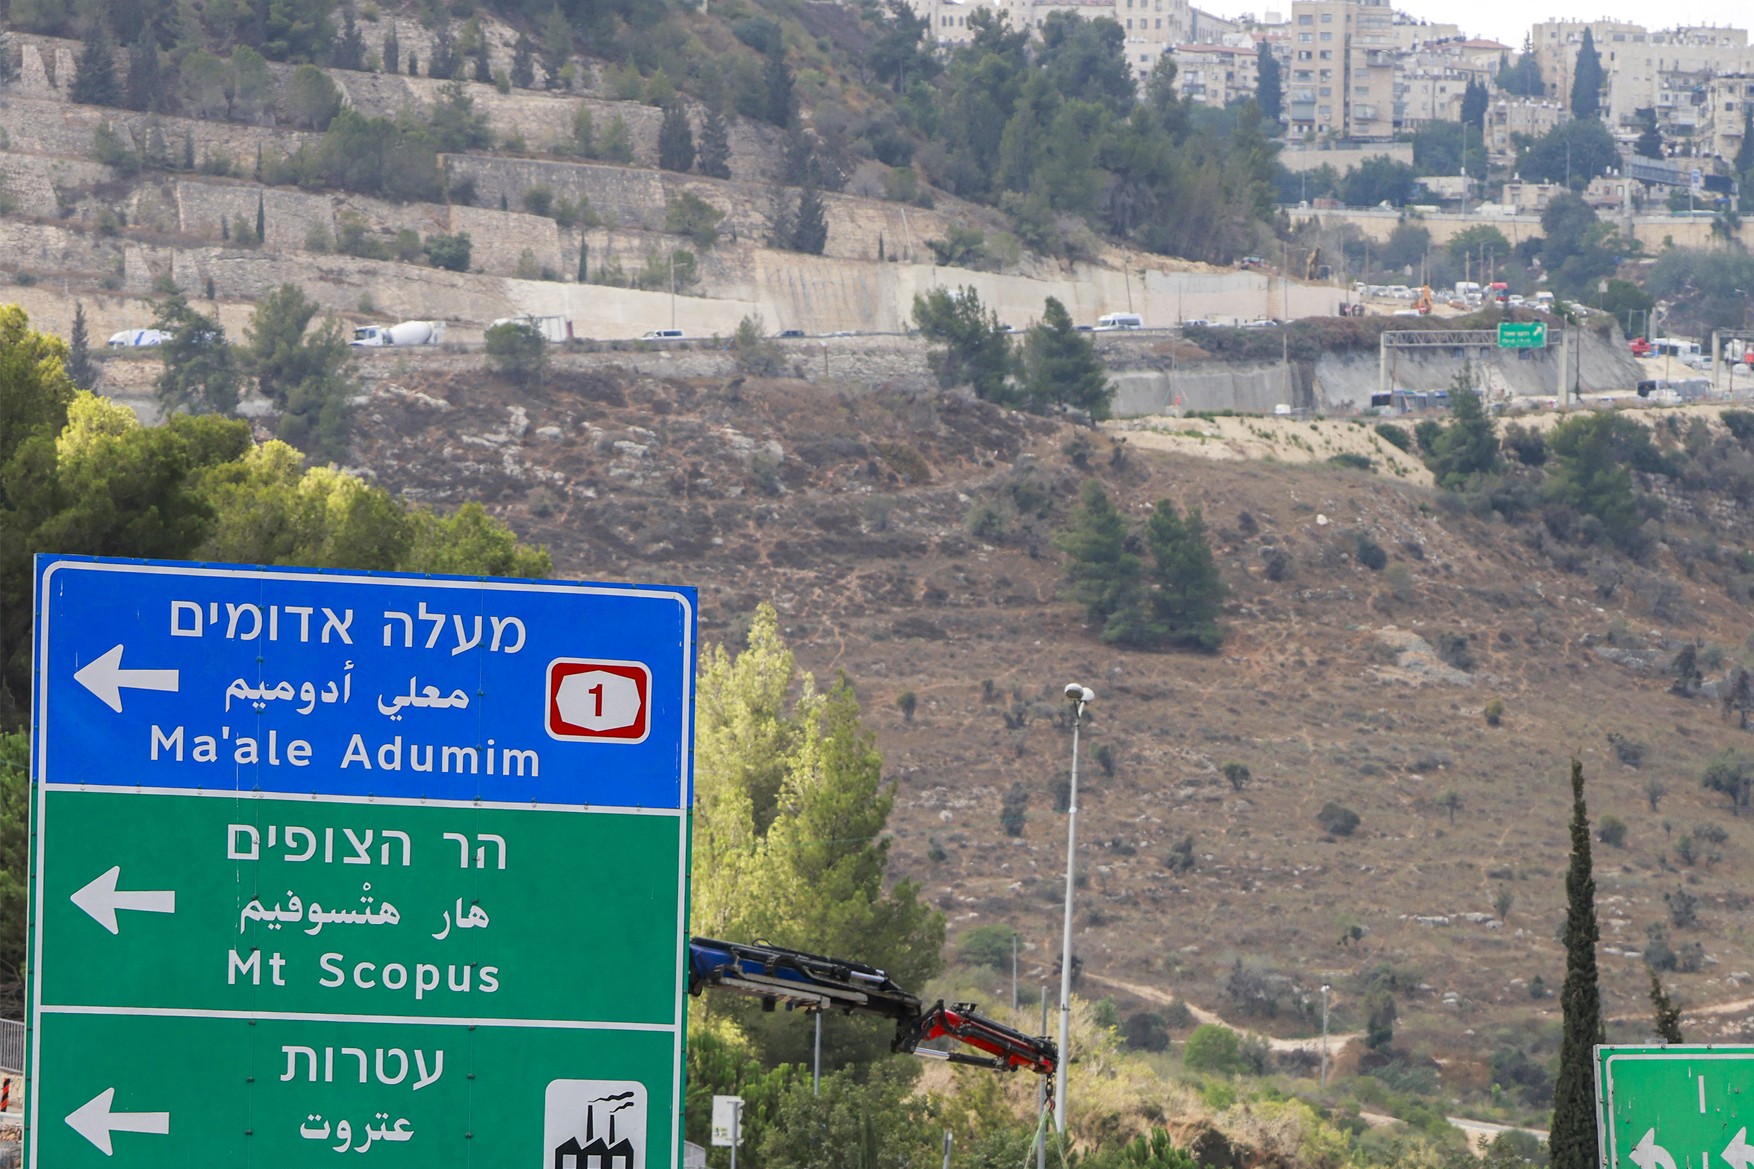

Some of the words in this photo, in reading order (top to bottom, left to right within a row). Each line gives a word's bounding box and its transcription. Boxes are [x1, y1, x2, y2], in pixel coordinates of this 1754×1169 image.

[170, 600, 353, 644] אדומים
[383, 602, 526, 656] מעלה
[225, 660, 354, 715] أدوميم
[377, 676, 470, 721] معلي
[586, 683, 604, 717] 1
[150, 725, 312, 767] Ma'ale
[340, 734, 539, 777] Adumim
[227, 824, 411, 866] הצופים
[443, 832, 506, 870] הר
[432, 897, 490, 940] هار
[228, 949, 286, 986] Mt
[319, 952, 499, 1000] Scopus
[280, 1045, 444, 1091] עטרות
[300, 1112, 414, 1153] عتروت
